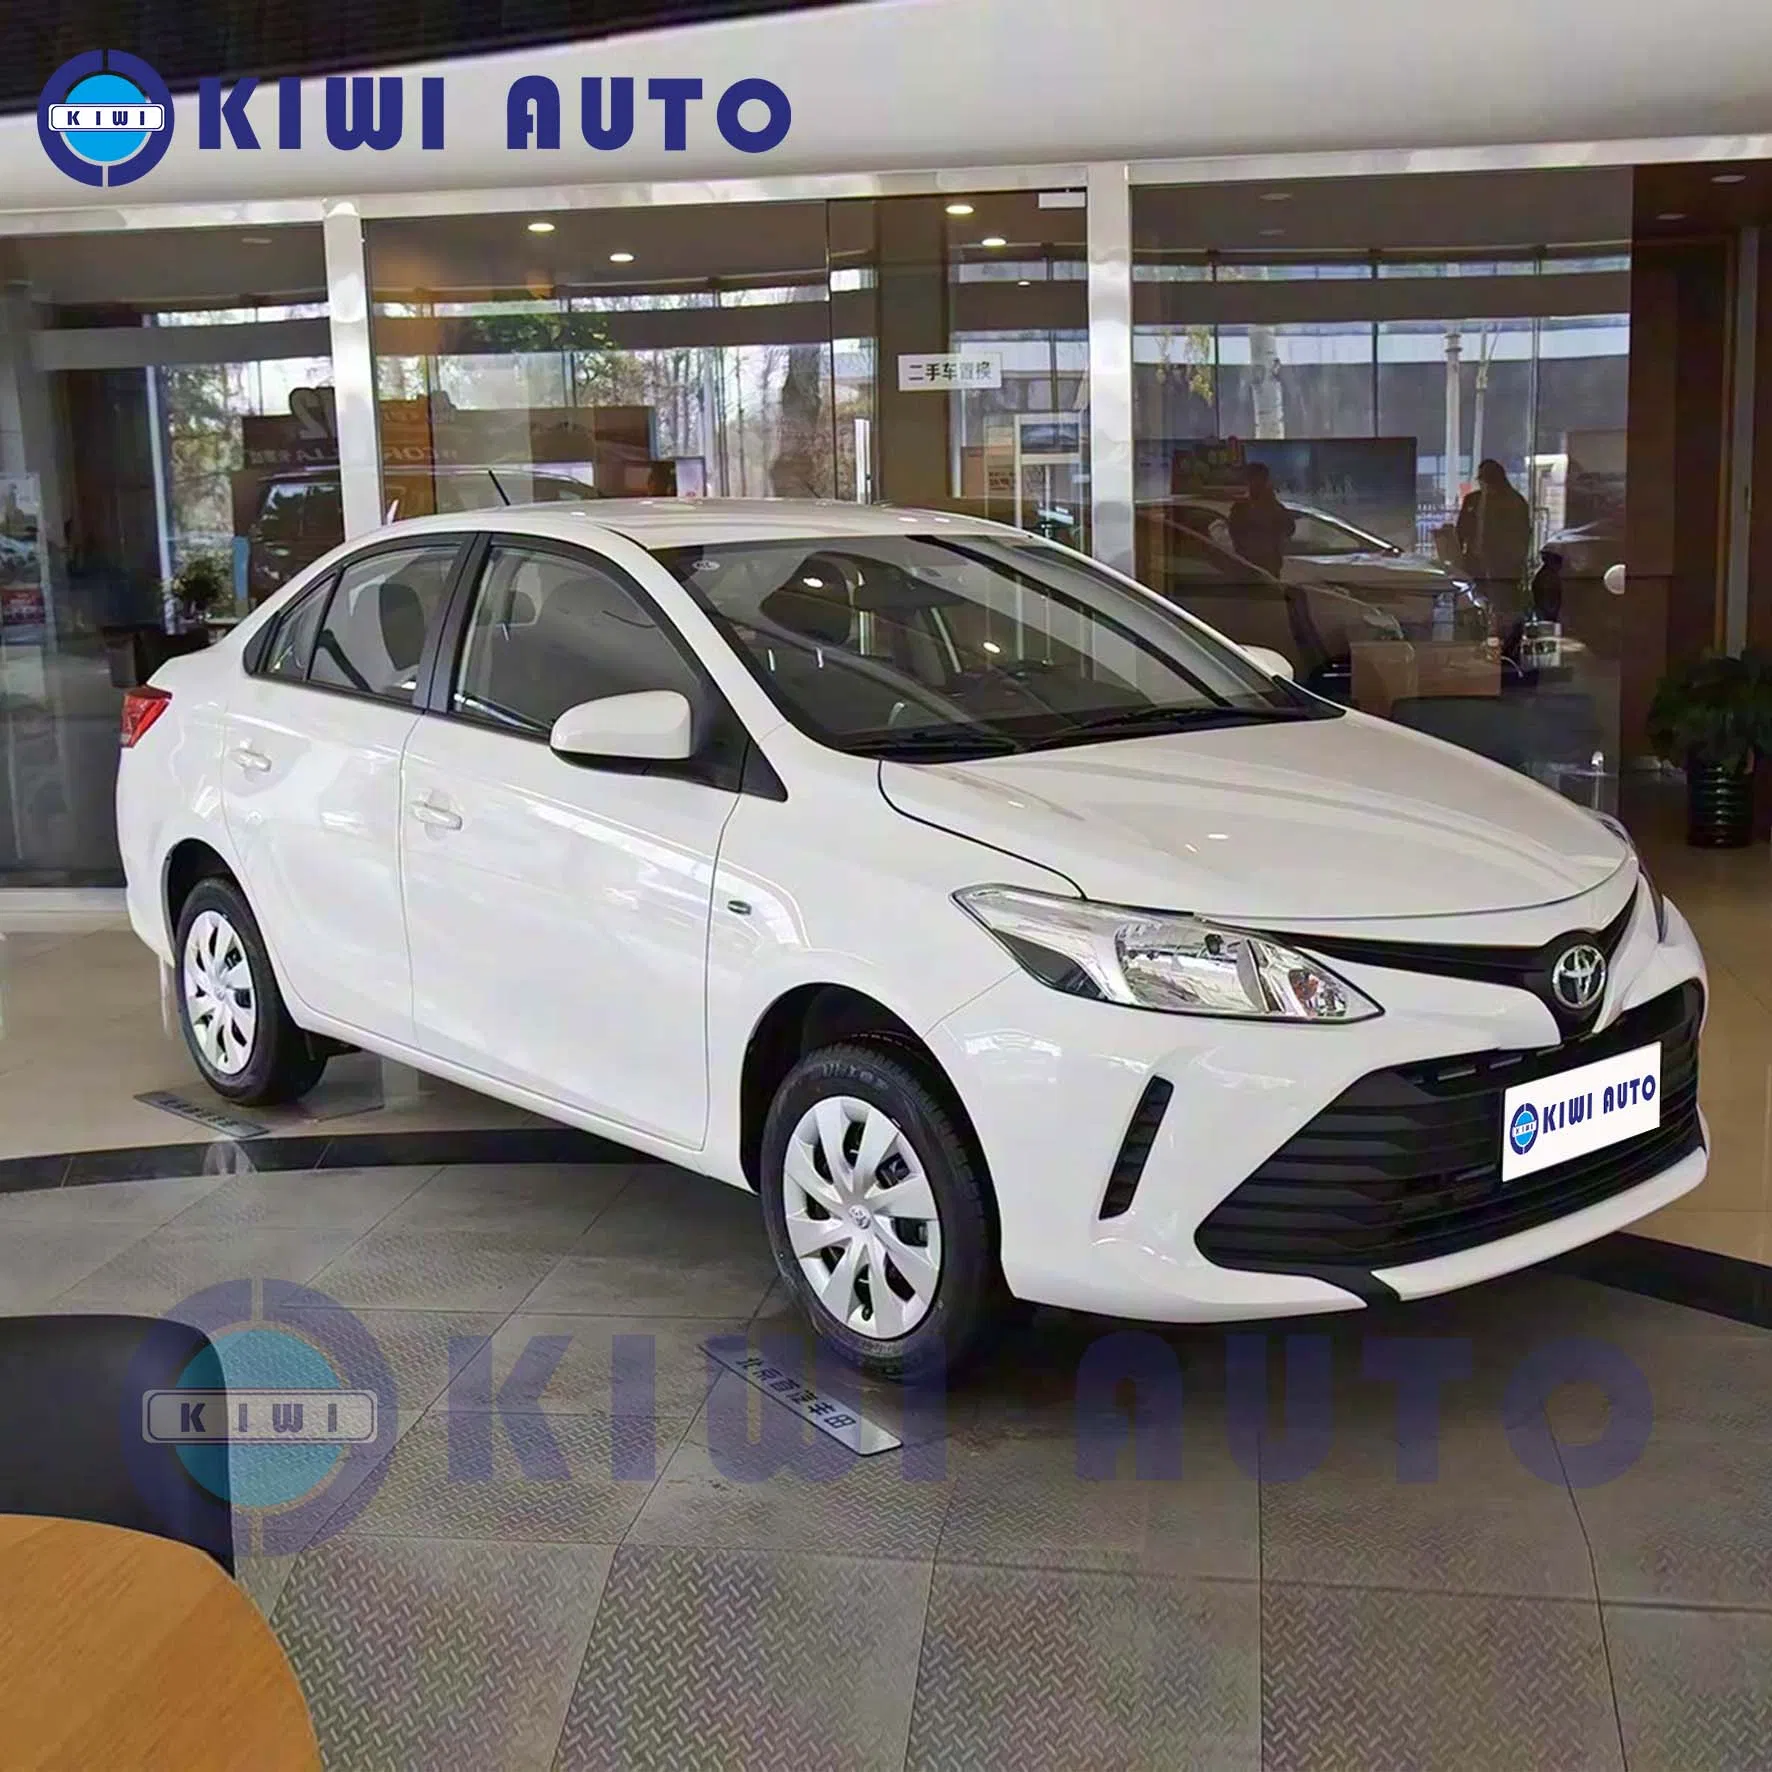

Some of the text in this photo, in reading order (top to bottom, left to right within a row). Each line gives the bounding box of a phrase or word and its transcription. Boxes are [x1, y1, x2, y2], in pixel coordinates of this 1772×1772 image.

[908, 360, 993, 382] 二手车置换
